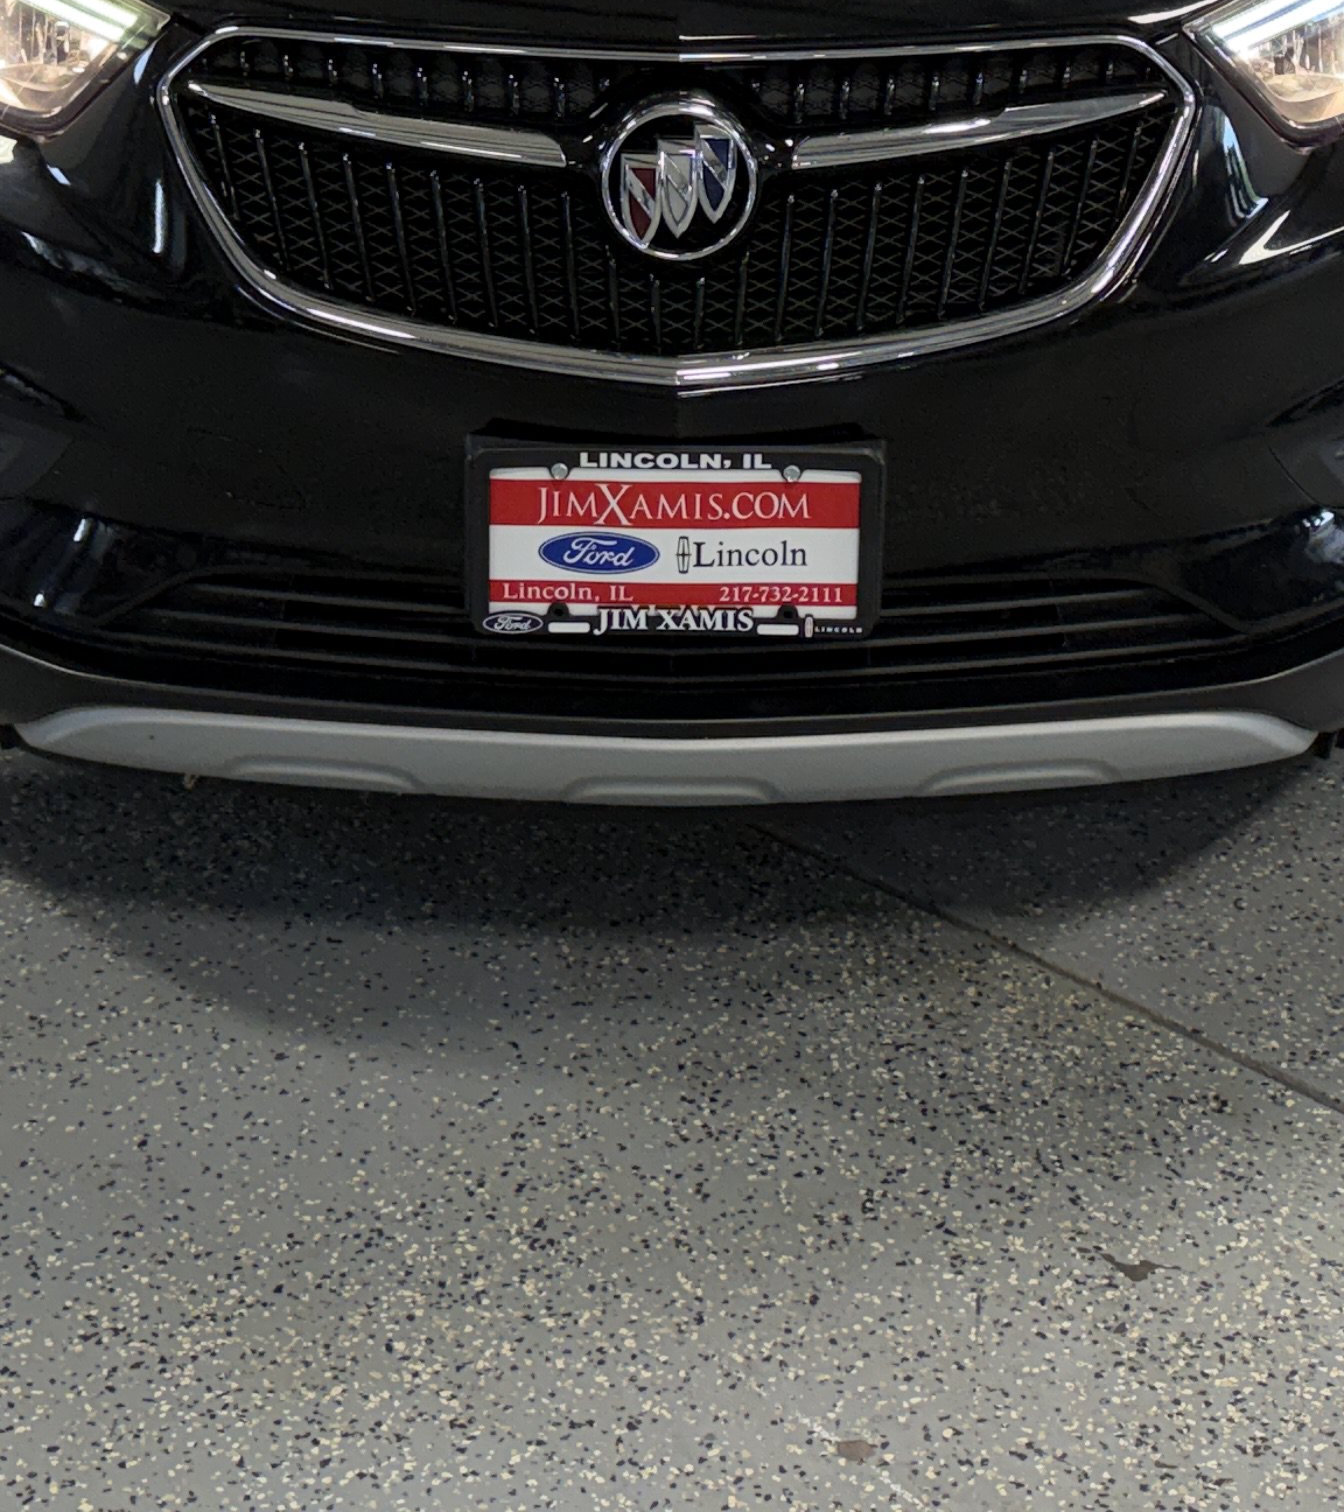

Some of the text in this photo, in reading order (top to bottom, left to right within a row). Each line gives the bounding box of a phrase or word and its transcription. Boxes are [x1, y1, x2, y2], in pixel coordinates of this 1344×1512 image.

[579, 452, 772, 469] LINCOLN, IL
[537, 483, 812, 526] JIMXAMIS.COM
[563, 538, 633, 566] Ford
[693, 540, 808, 568] Lincoln
[503, 583, 633, 602] Lincoln, IL
[720, 586, 842, 602] 217-732-2111
[593, 608, 754, 636] JIM XAMIS
